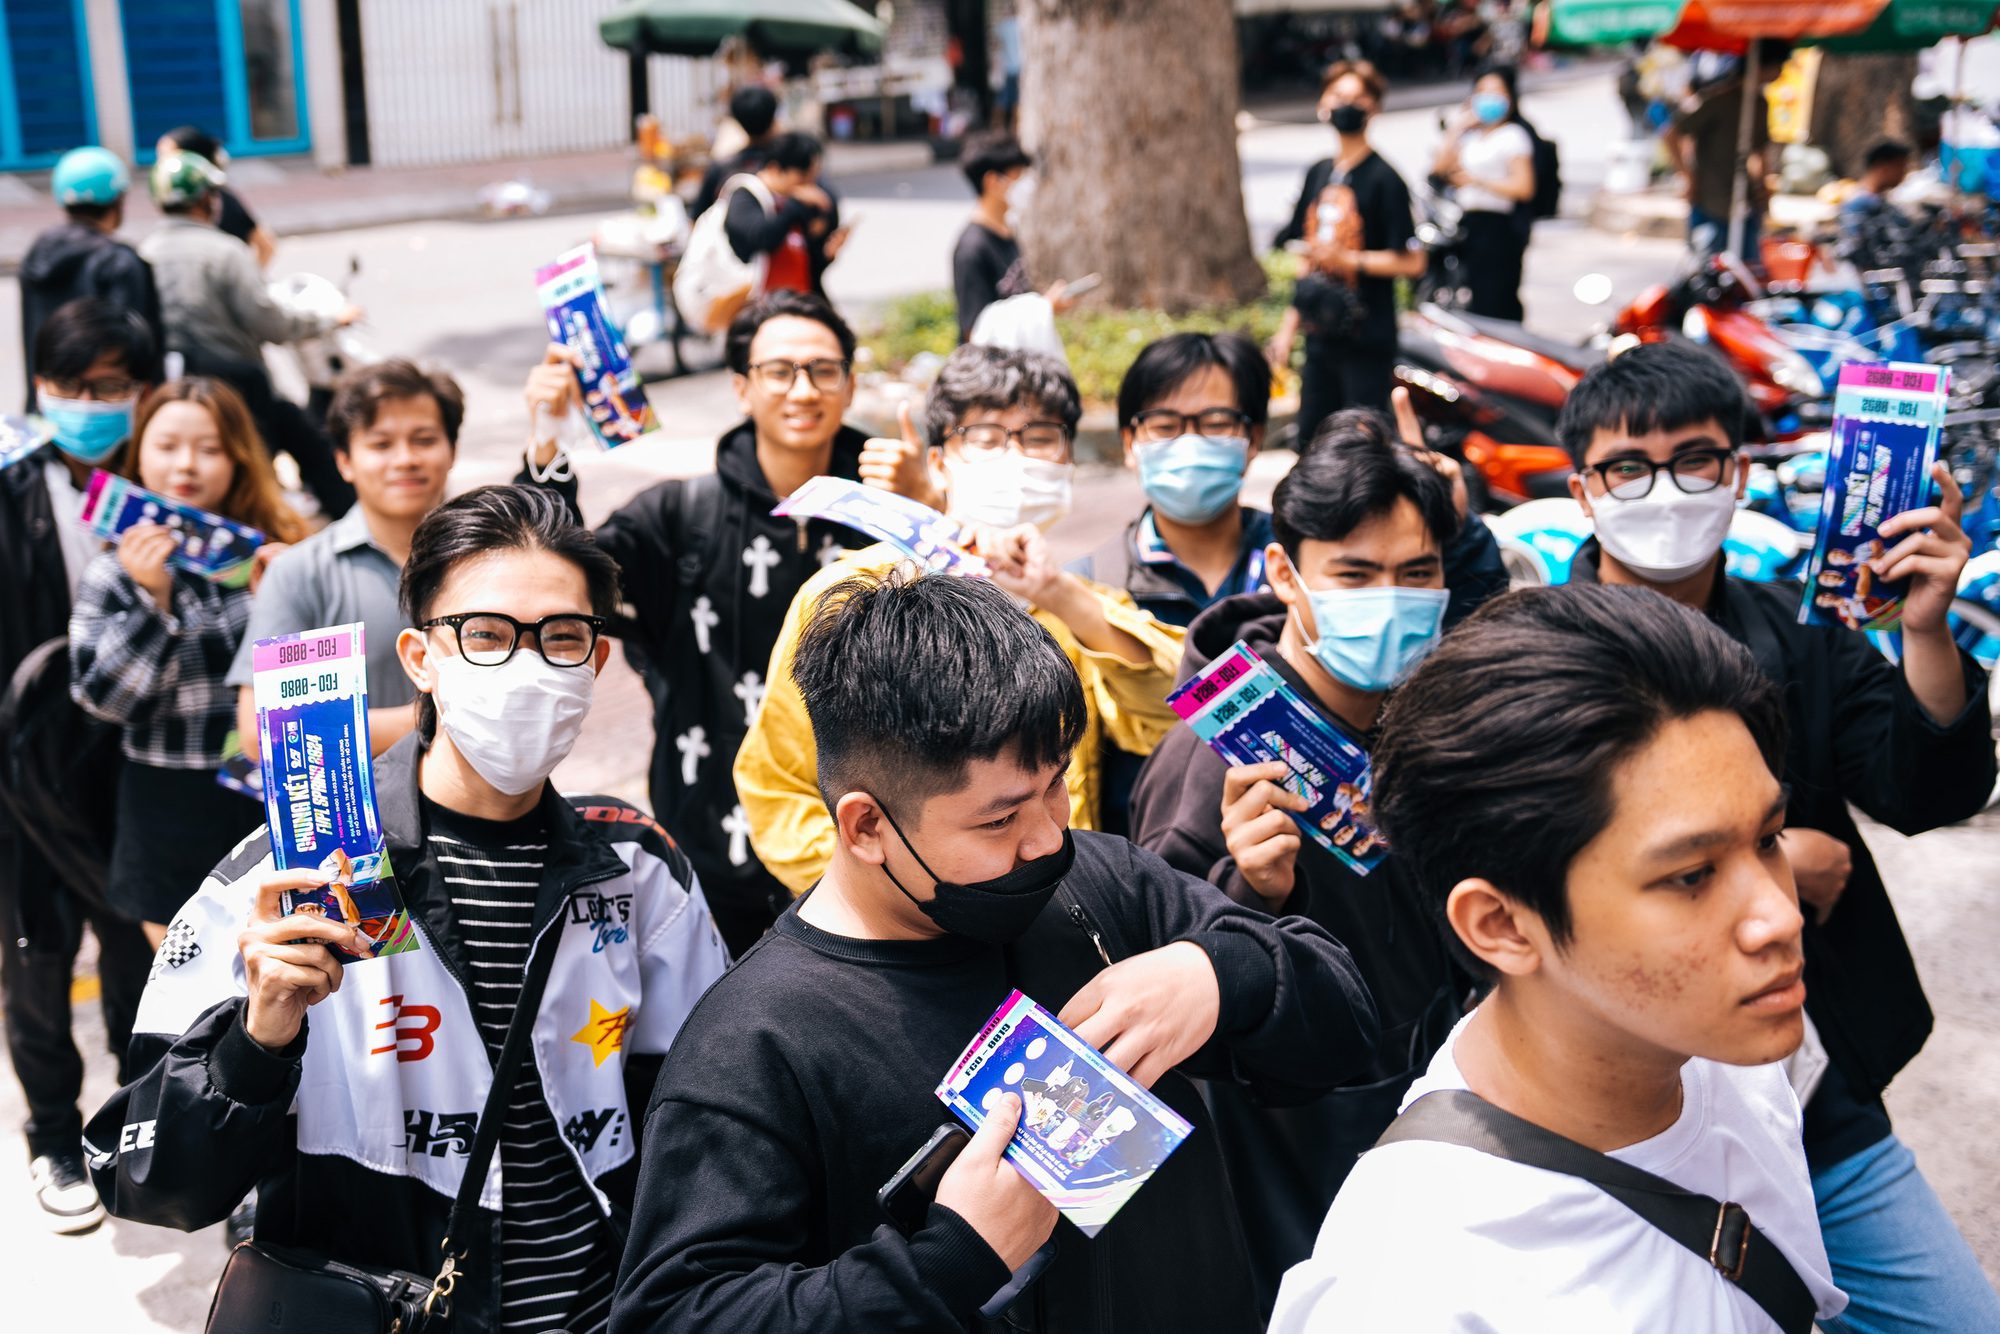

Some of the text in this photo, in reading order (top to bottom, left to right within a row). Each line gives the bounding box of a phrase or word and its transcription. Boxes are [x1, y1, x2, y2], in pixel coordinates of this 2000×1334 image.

[319, 673, 338, 692] FCO
[283, 773, 309, 799] KẾT
[306, 734, 332, 835] FVPL SPRING 2024
[290, 801, 317, 852] CHUNG
[964, 1055, 983, 1077] FCO
